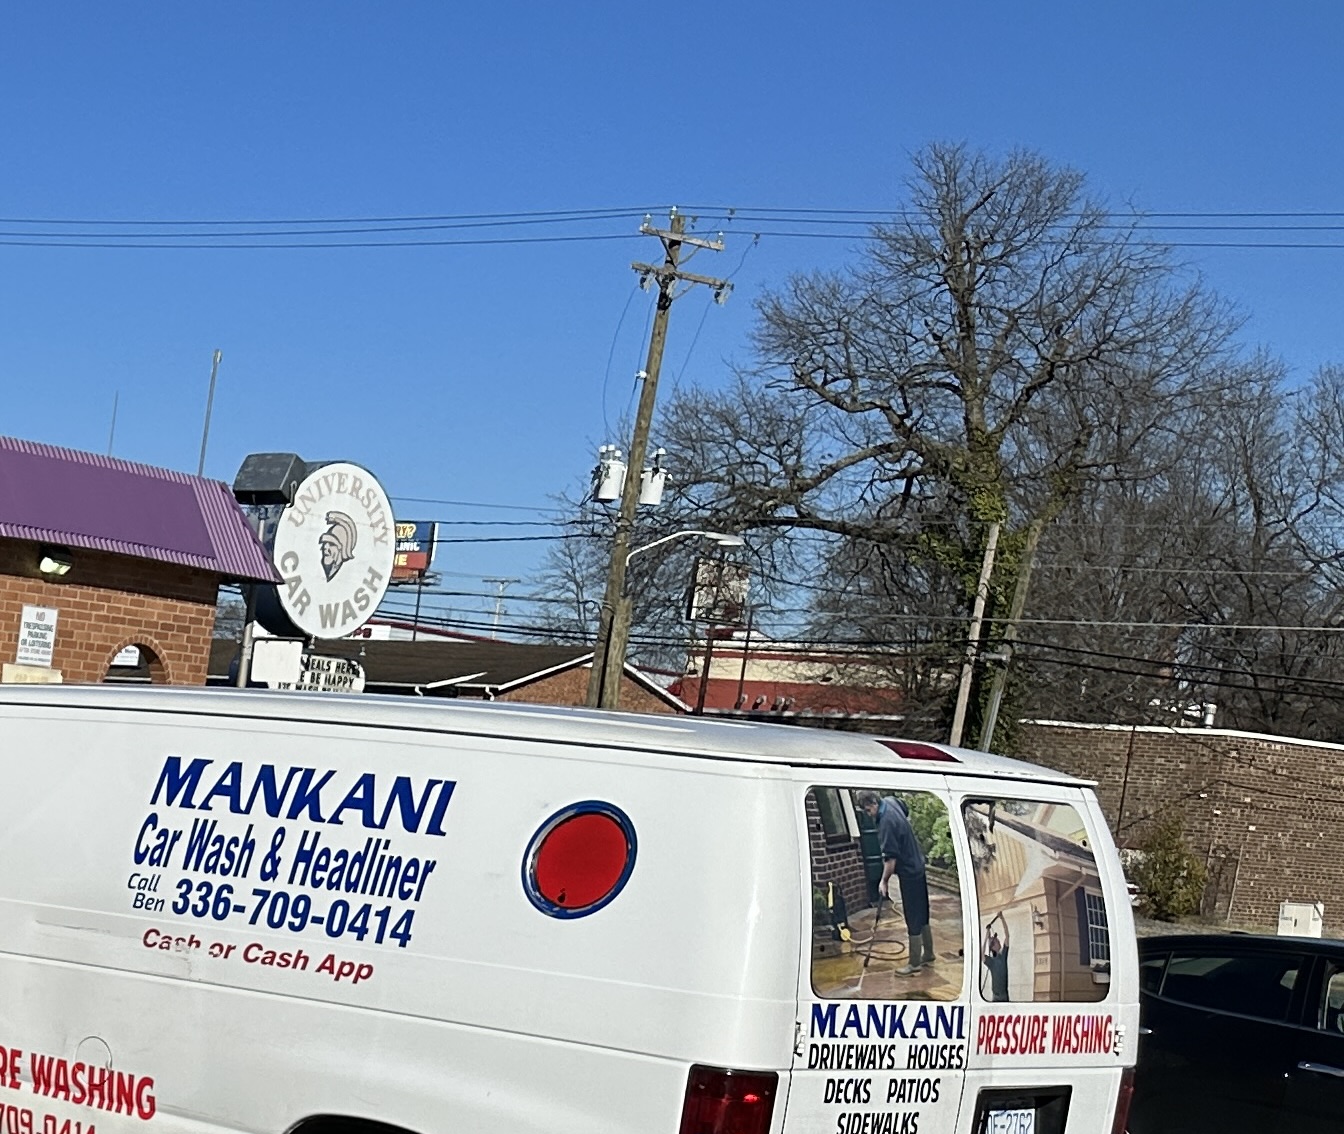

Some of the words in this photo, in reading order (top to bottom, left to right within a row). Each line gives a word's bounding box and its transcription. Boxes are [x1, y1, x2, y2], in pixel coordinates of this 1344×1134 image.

[287, 472, 391, 546] UNIVERSITY
[281, 551, 311, 616] CAR
[318, 566, 383, 629] WASH
[311, 658, 331, 672] EALS
[325, 673, 355, 688] HAPPY
[149, 756, 457, 837] MANKANI
[134, 812, 182, 868] Car
[182, 818, 255, 878] Wash
[260, 826, 286, 882] &
[288, 831, 436, 902] Headliner
[128, 872, 161, 893] Call
[133, 892, 165, 912] Ben
[172, 878, 415, 948] 336-709-0414
[143, 928, 201, 952] Cash
[209, 943, 236, 959] or
[243, 943, 310, 971] Cash
[316, 953, 374, 984] App
[810, 1003, 965, 1039] MANKANI
[976, 1014, 1048, 1055] PRESSURE
[1052, 1014, 1112, 1054] WASHING
[808, 1044, 896, 1069] DRIVEWAYS
[906, 1044, 963, 1069] HOUSES
[31, 1052, 157, 1120] WASHING
[824, 1078, 871, 1104] DECKS
[886, 1078, 941, 1104] PATIOS
